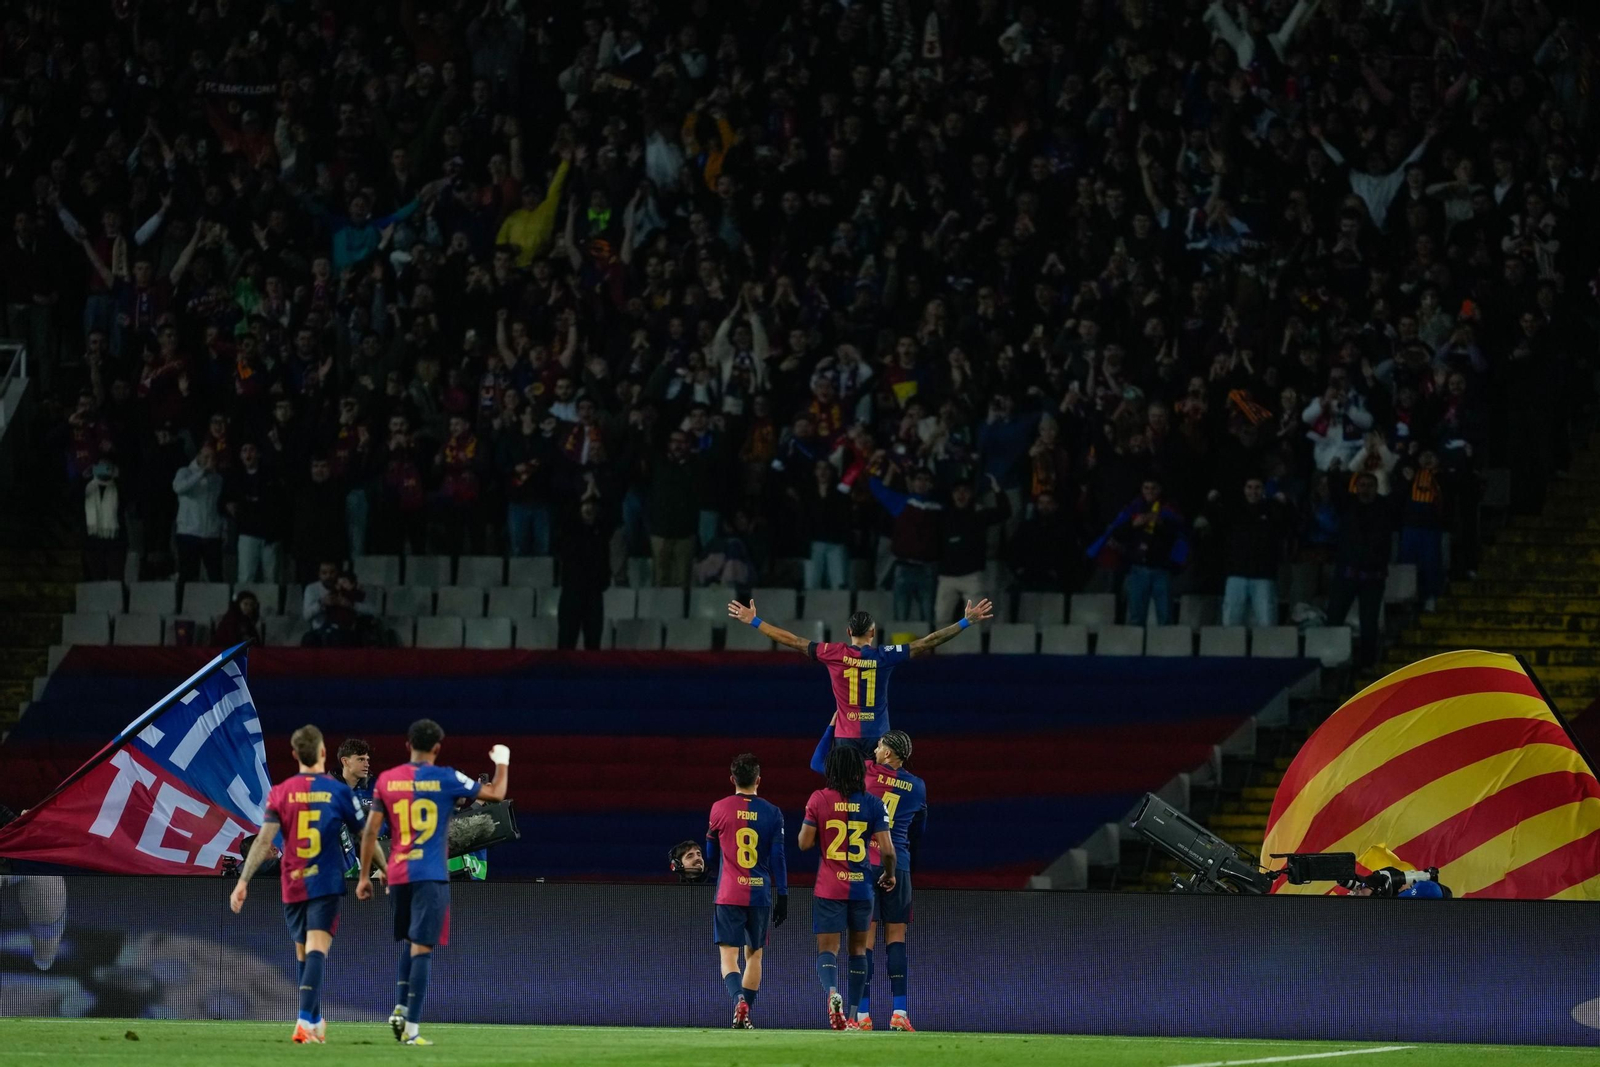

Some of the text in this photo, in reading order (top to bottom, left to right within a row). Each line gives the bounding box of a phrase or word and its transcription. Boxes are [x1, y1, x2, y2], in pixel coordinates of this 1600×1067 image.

[843, 656, 877, 669] RAPHINHA
[844, 667, 876, 707] 11
[885, 776, 913, 792] ARAUJO
[296, 810, 322, 858] 5
[393, 798, 438, 845] 19
[737, 810, 758, 821] PEDRI
[736, 827, 759, 869] 8
[825, 819, 868, 862] 23
